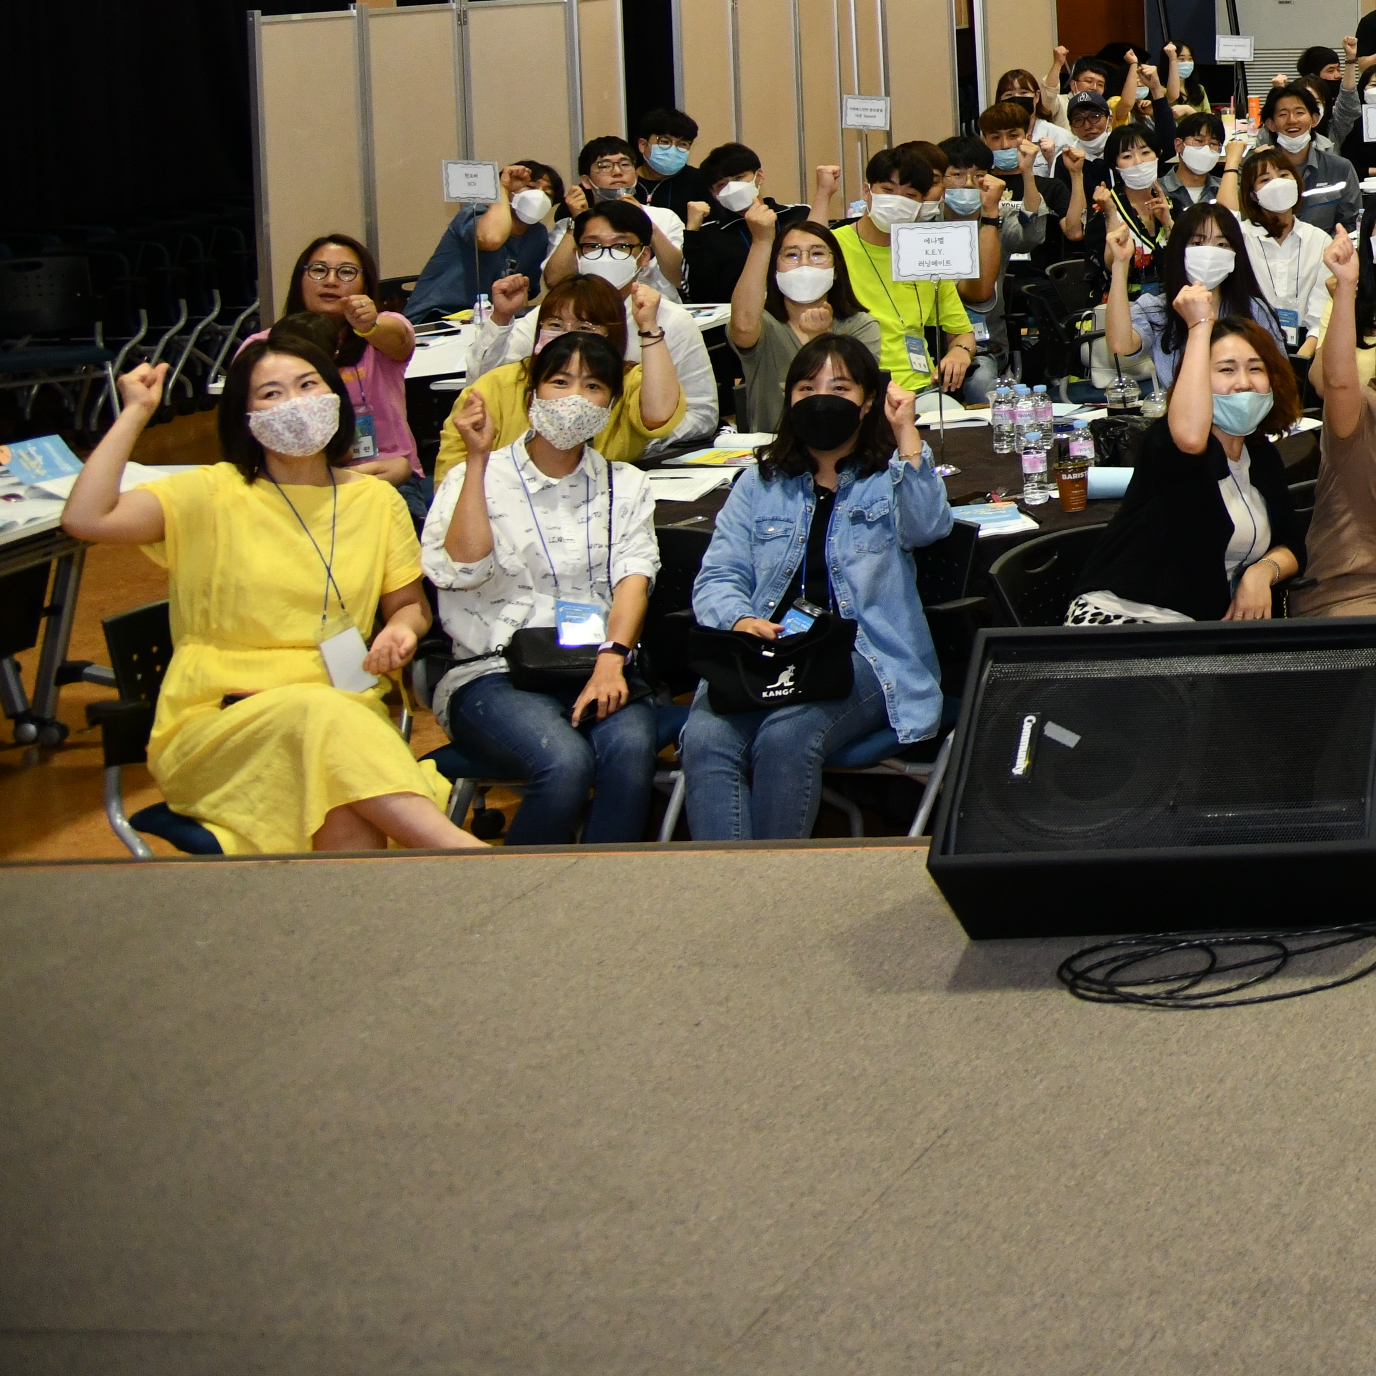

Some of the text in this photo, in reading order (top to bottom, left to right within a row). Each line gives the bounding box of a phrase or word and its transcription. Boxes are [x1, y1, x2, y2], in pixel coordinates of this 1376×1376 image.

[918, 260, 952, 268] 러닝메이트
[762, 687, 802, 698] KANG
[1011, 715, 1037, 775] Community
